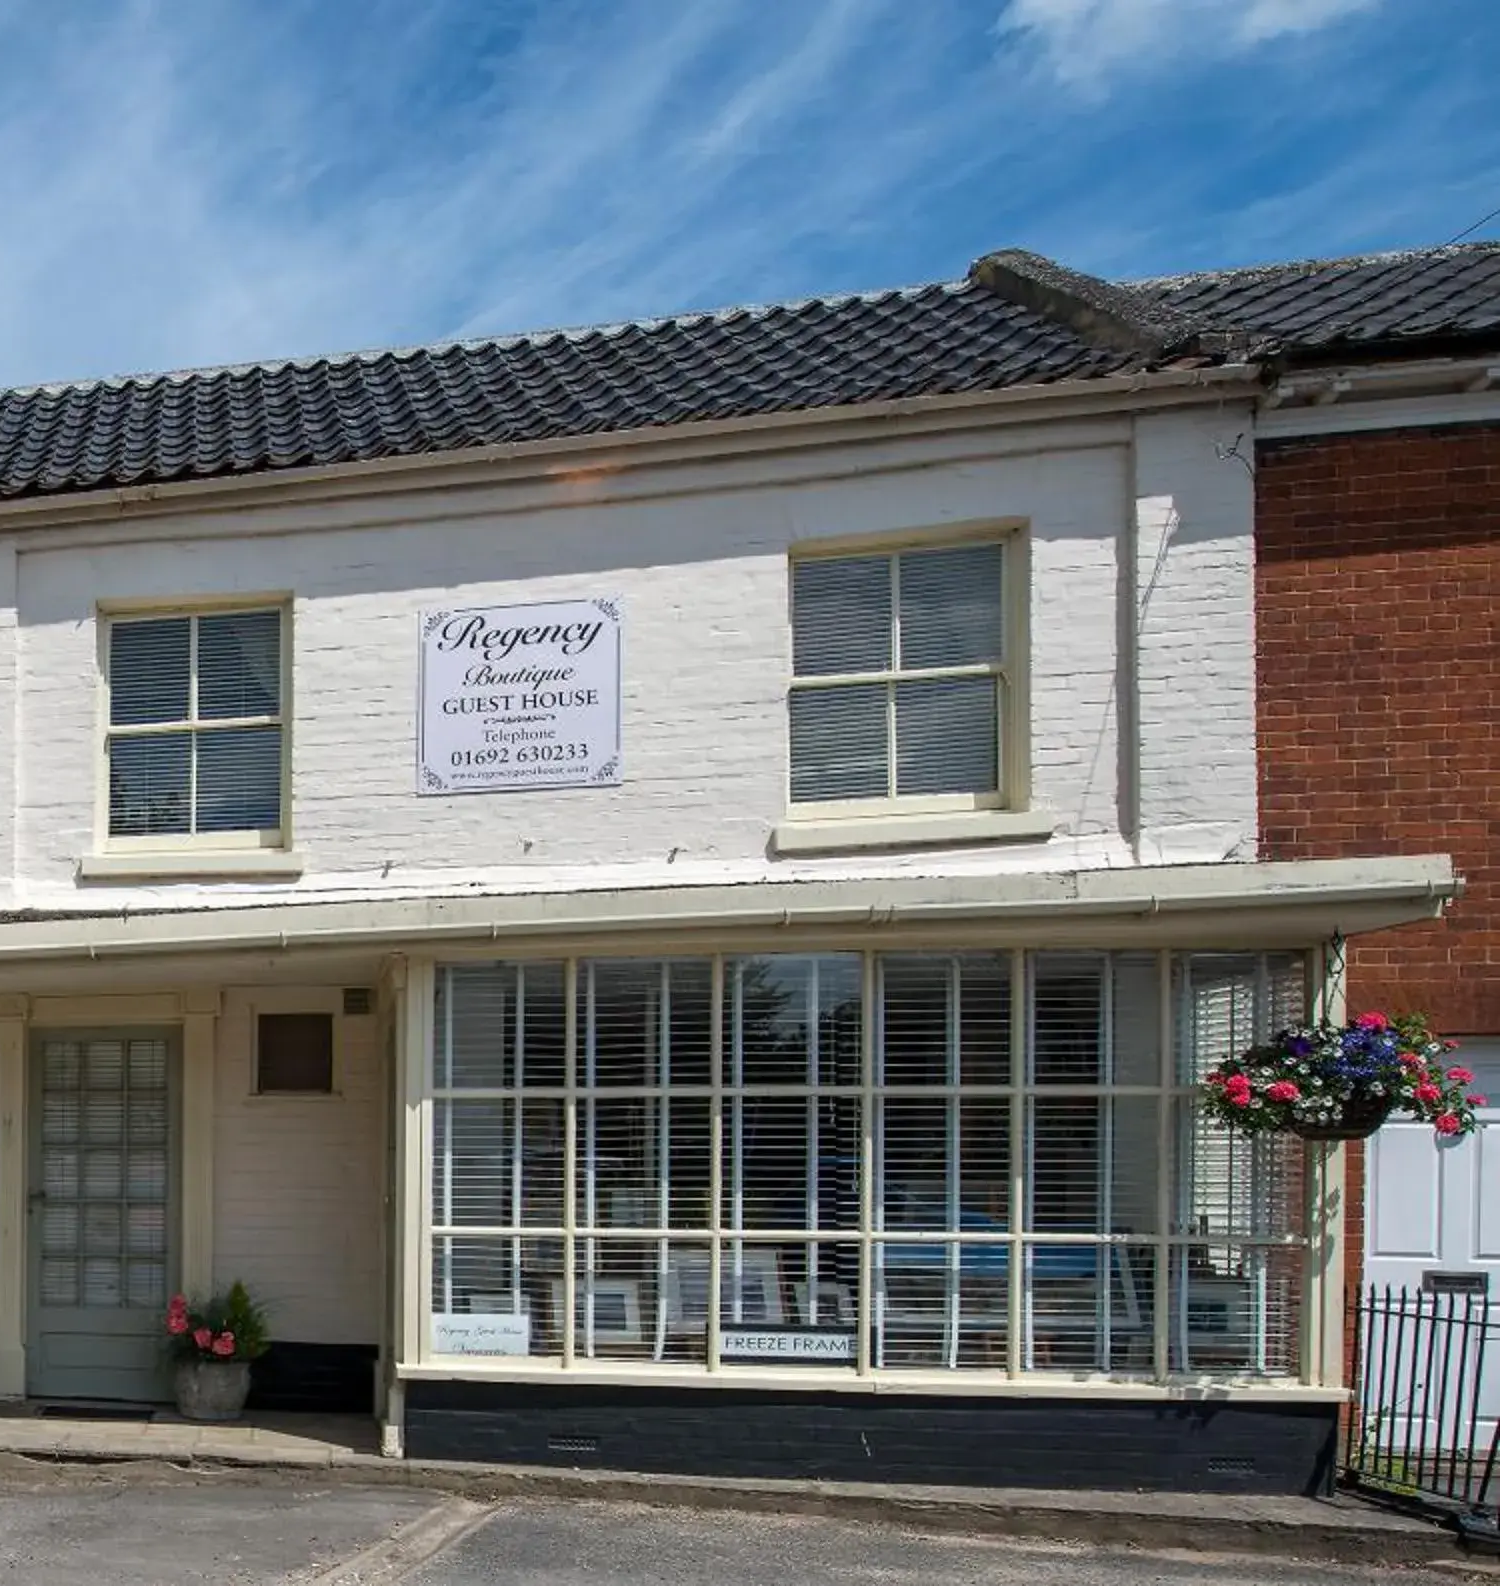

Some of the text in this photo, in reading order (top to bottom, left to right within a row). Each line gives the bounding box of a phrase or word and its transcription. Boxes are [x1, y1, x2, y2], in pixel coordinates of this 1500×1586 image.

[438, 615, 603, 661] Regency
[462, 665, 575, 691] Boutique
[443, 689, 599, 715] GUEST HOUSE
[484, 729, 556, 744] Telephone
[451, 743, 589, 766] 01692 630233
[725, 1337, 858, 1353] FREEZE FRAME
